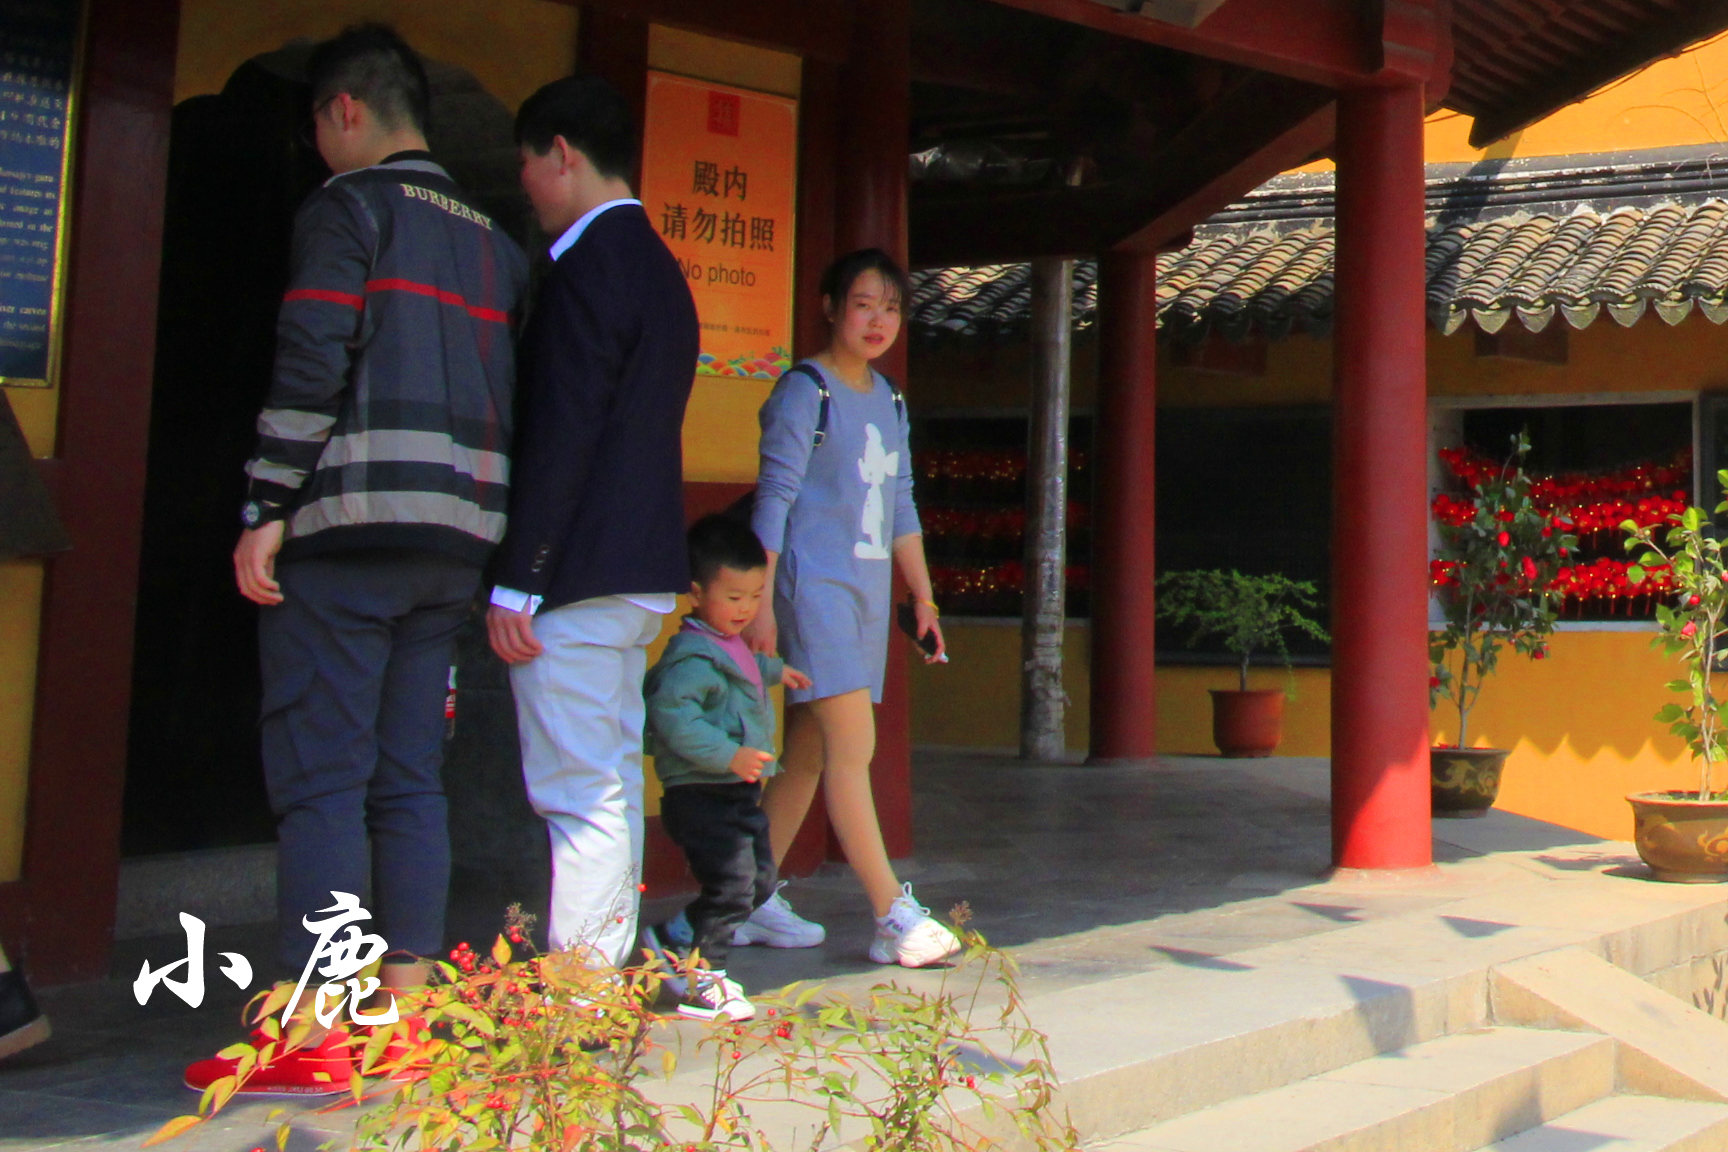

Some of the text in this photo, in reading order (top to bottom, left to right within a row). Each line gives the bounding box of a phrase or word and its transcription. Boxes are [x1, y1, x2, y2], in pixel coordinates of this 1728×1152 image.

[399, 183, 493, 231] BURBERRY
[661, 201, 775, 252] 请勿拍照
[677, 256, 757, 288] No photo
